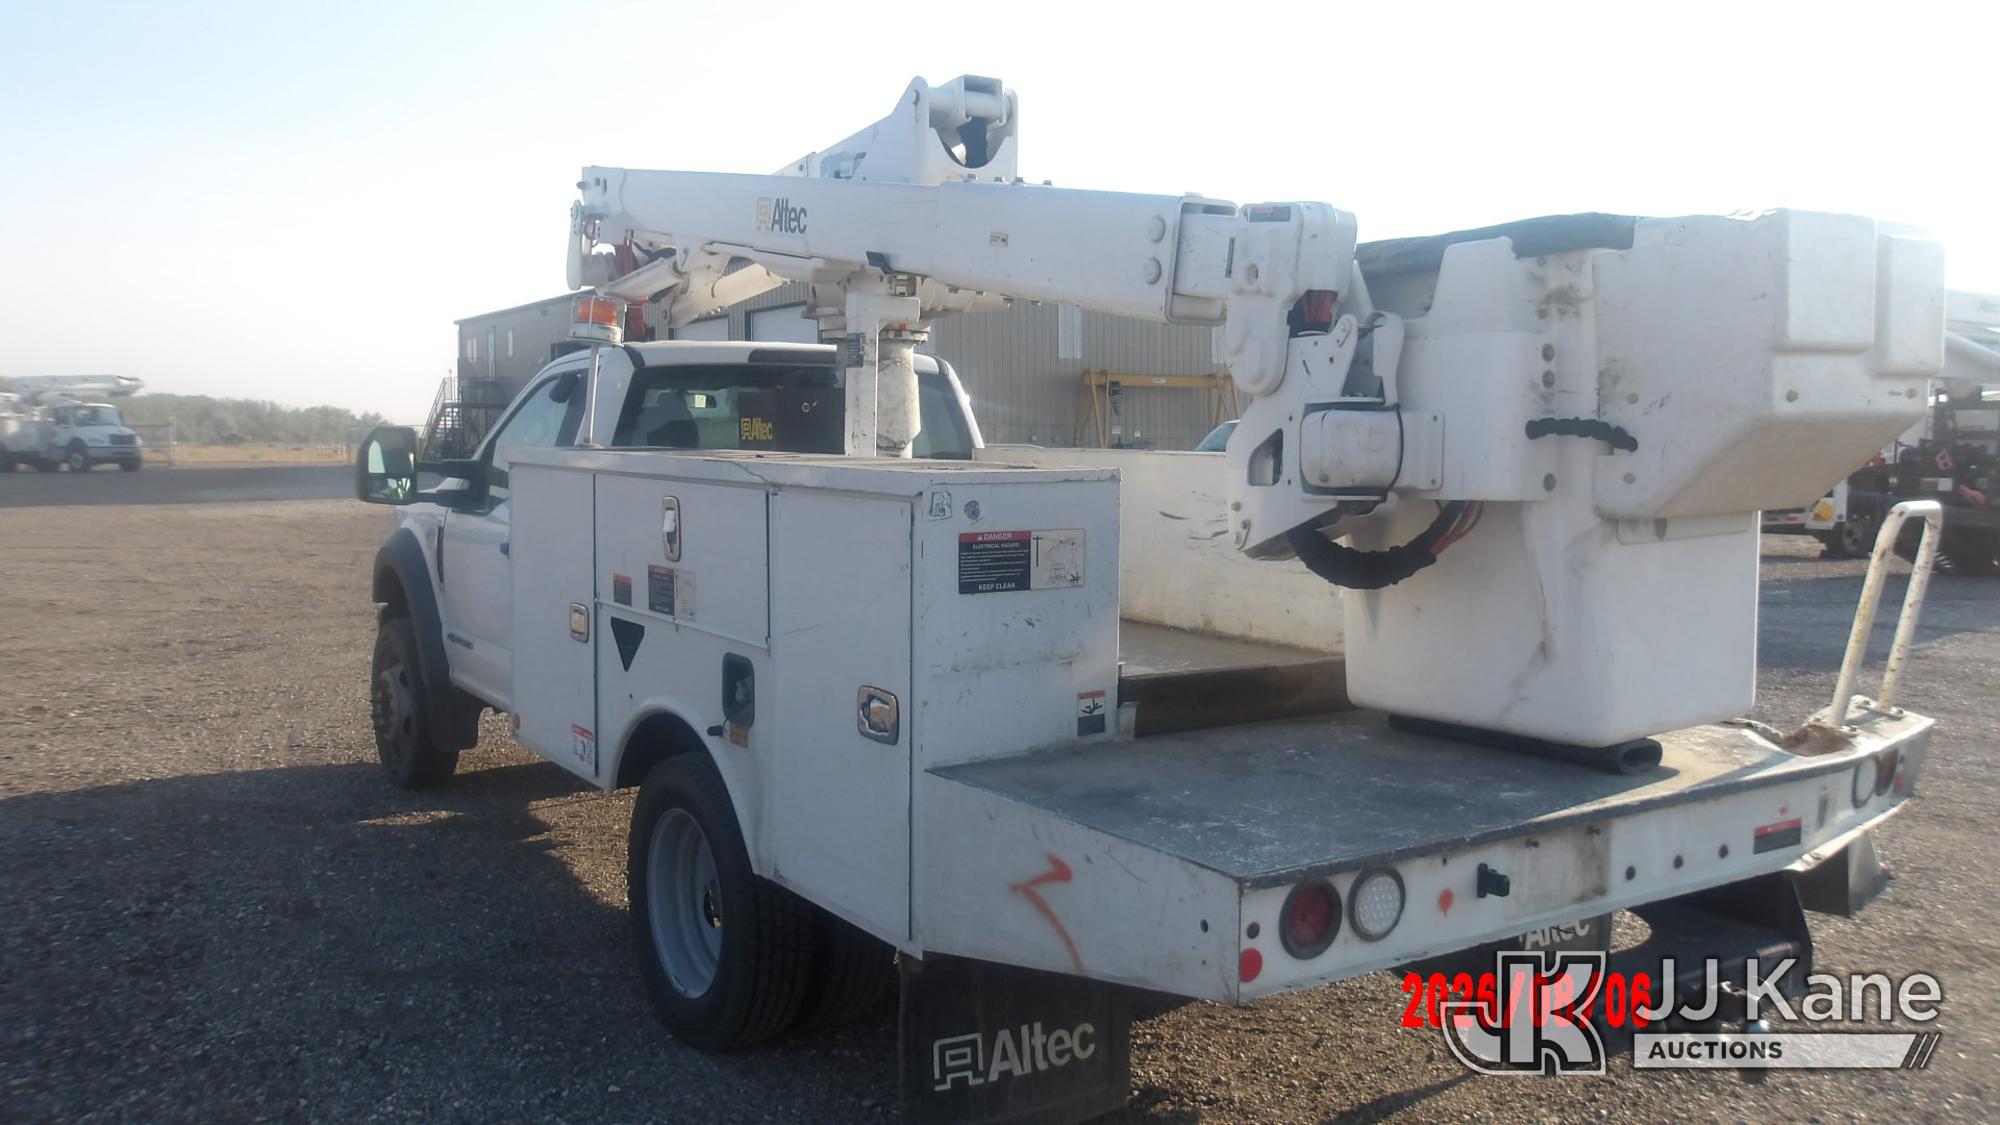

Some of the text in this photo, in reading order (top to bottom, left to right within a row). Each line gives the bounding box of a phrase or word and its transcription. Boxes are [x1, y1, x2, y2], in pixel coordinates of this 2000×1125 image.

[771, 198, 807, 234] Altec
[983, 532, 1012, 541] DANGER
[978, 582, 1016, 591] KEEP CLEAR
[988, 1021, 1096, 1082] Altec
